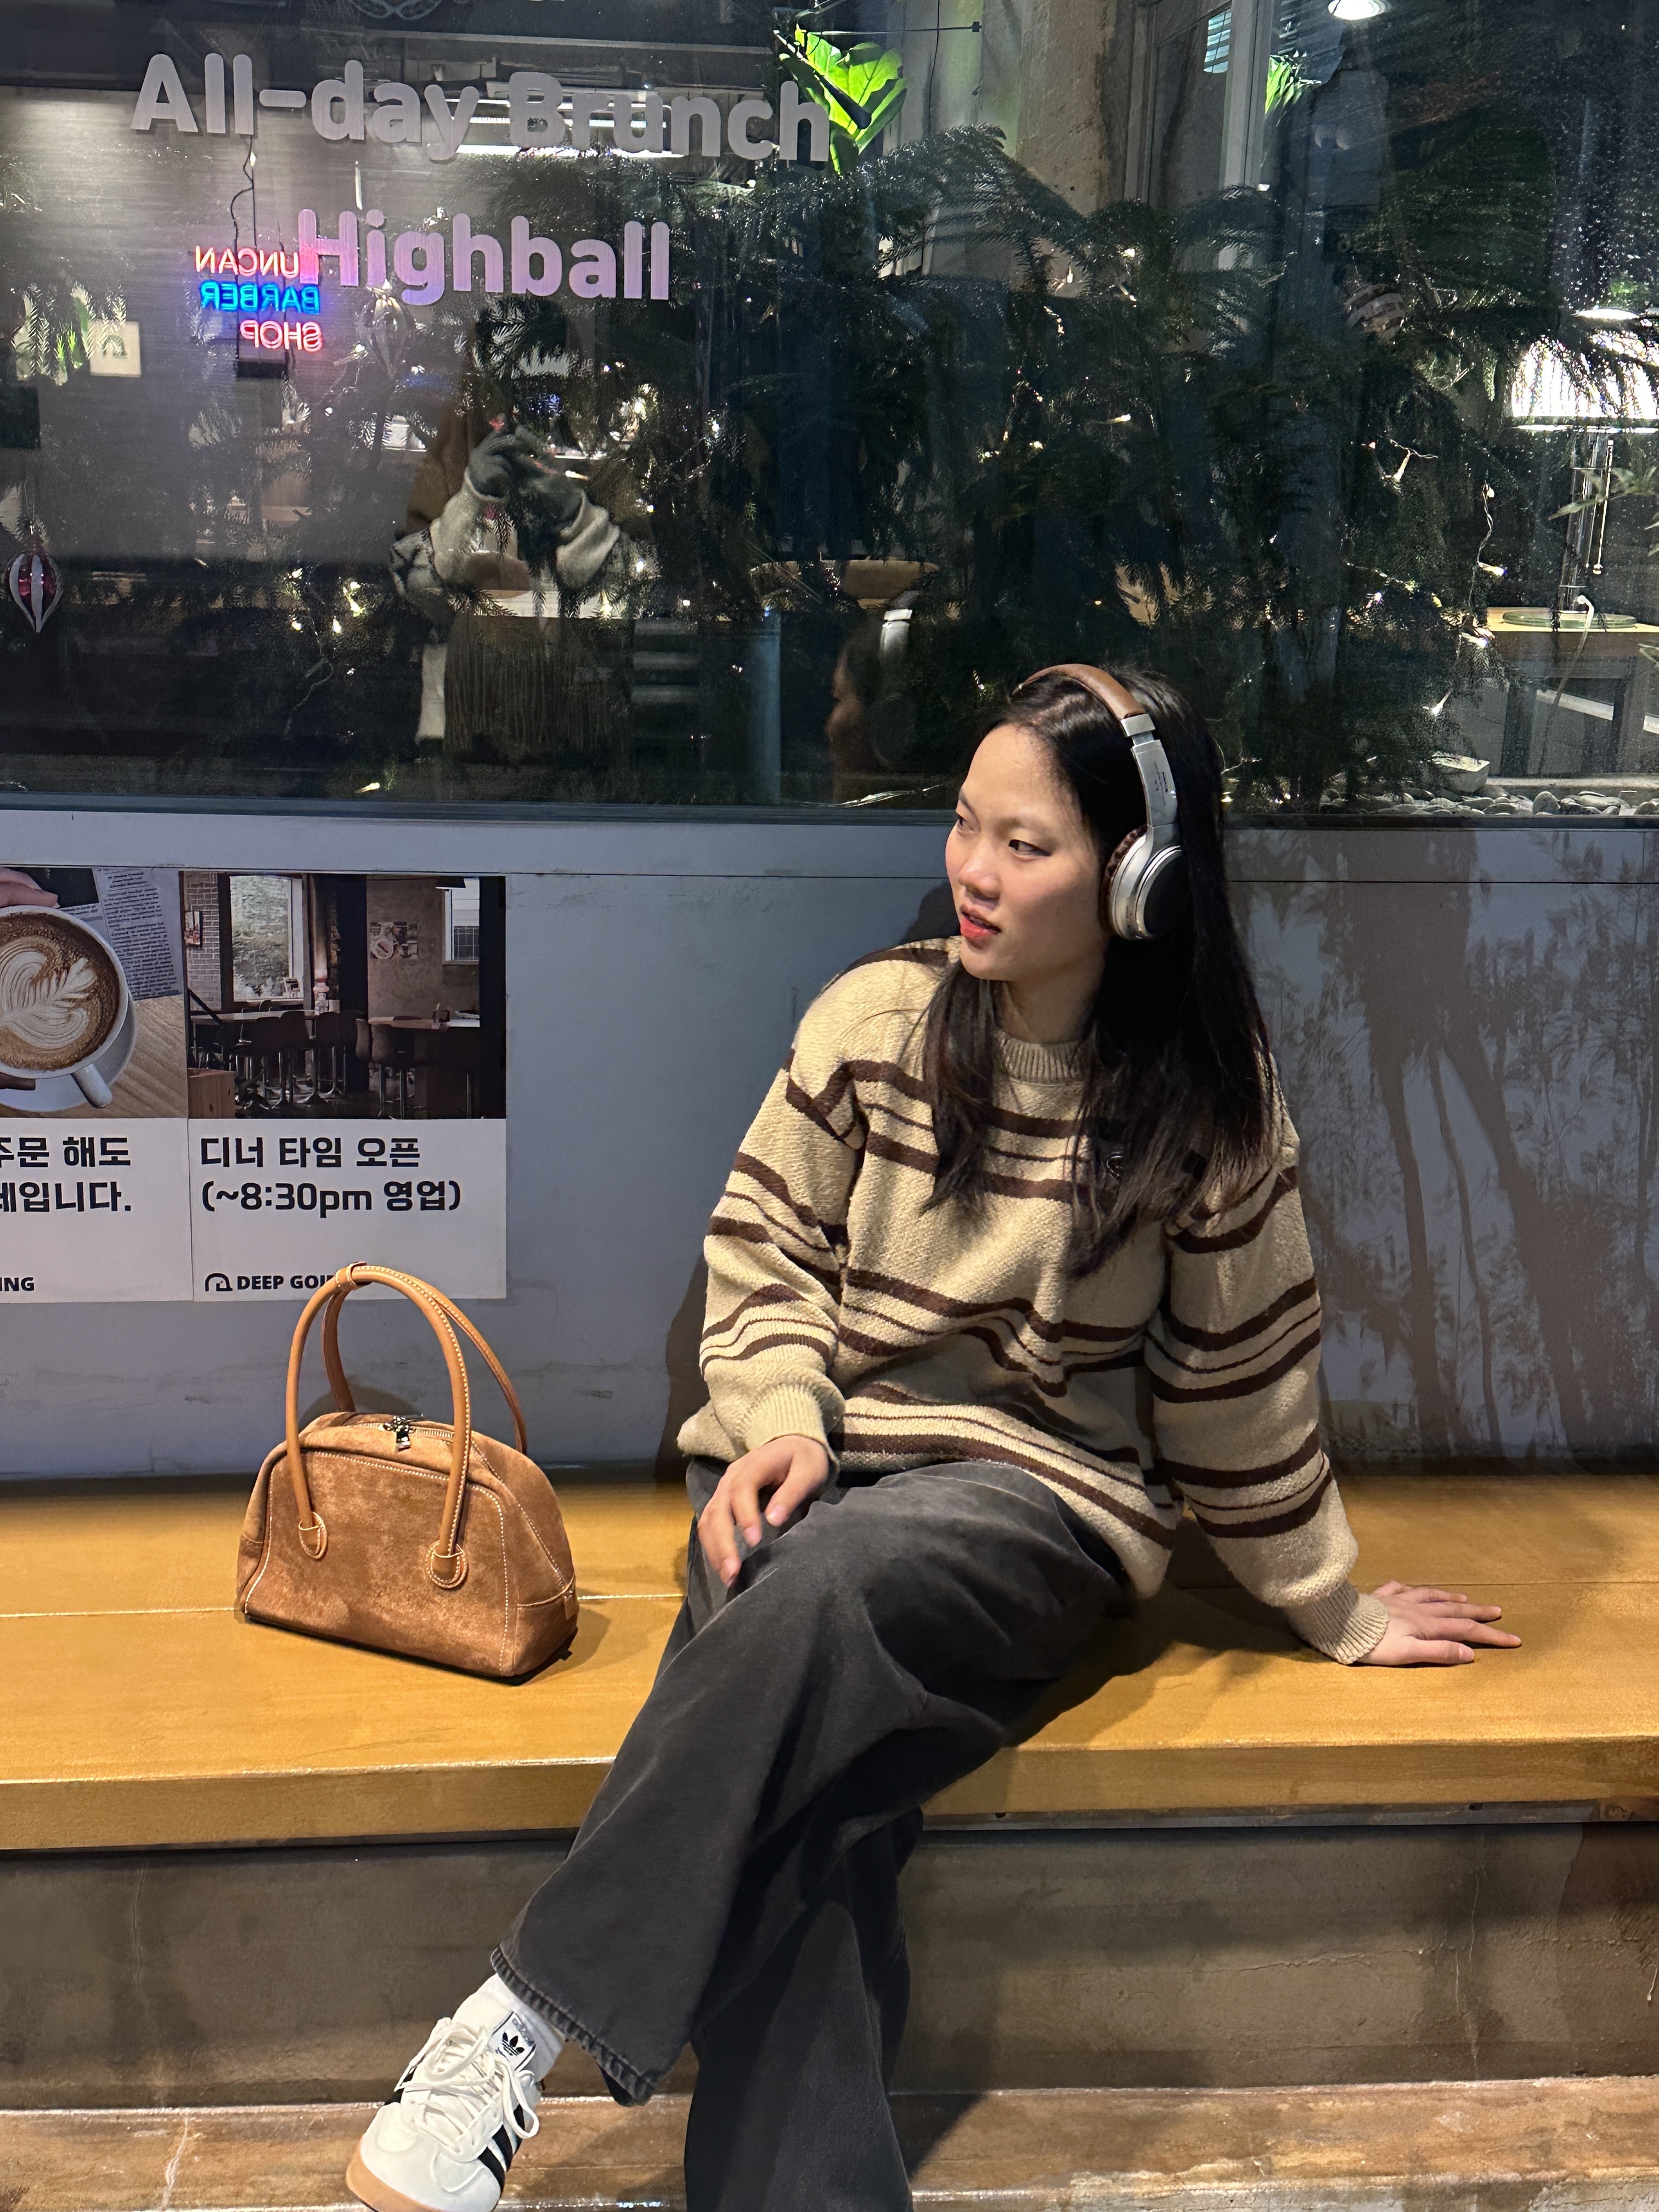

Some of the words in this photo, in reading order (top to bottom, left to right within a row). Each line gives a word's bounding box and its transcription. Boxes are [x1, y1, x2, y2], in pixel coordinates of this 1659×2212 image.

[130, 53, 480, 161] All-day
[509, 71, 829, 161] Brunch
[298, 208, 670, 306] Highball
[63, 1136, 131, 1167] 해도
[201, 1137, 263, 1167] 디너
[279, 1137, 341, 1168] 타임
[356, 1137, 420, 1167] 오픈
[202, 1181, 372, 1218] (~8:30pm
[383, 1180, 461, 1211] 영업)
[237, 1276, 284, 1290] DEEP
